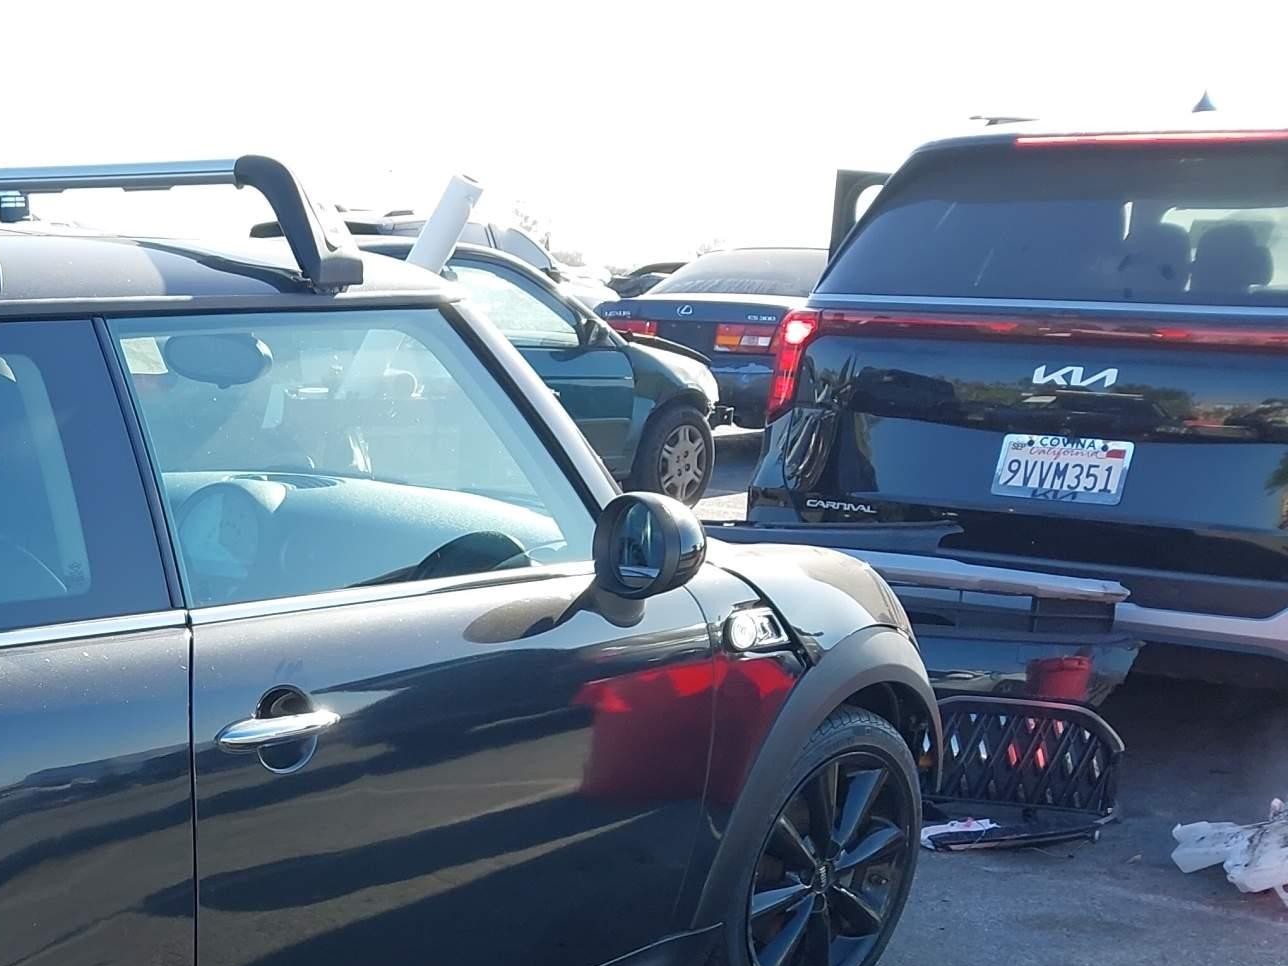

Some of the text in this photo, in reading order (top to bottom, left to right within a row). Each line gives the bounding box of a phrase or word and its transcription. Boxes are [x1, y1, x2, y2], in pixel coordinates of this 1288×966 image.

[1040, 436, 1096, 450] COVINA
[1029, 446, 1106, 460] California
[1002, 459, 1113, 493] 9VVM351
[806, 499, 877, 513] CARNIVAL
